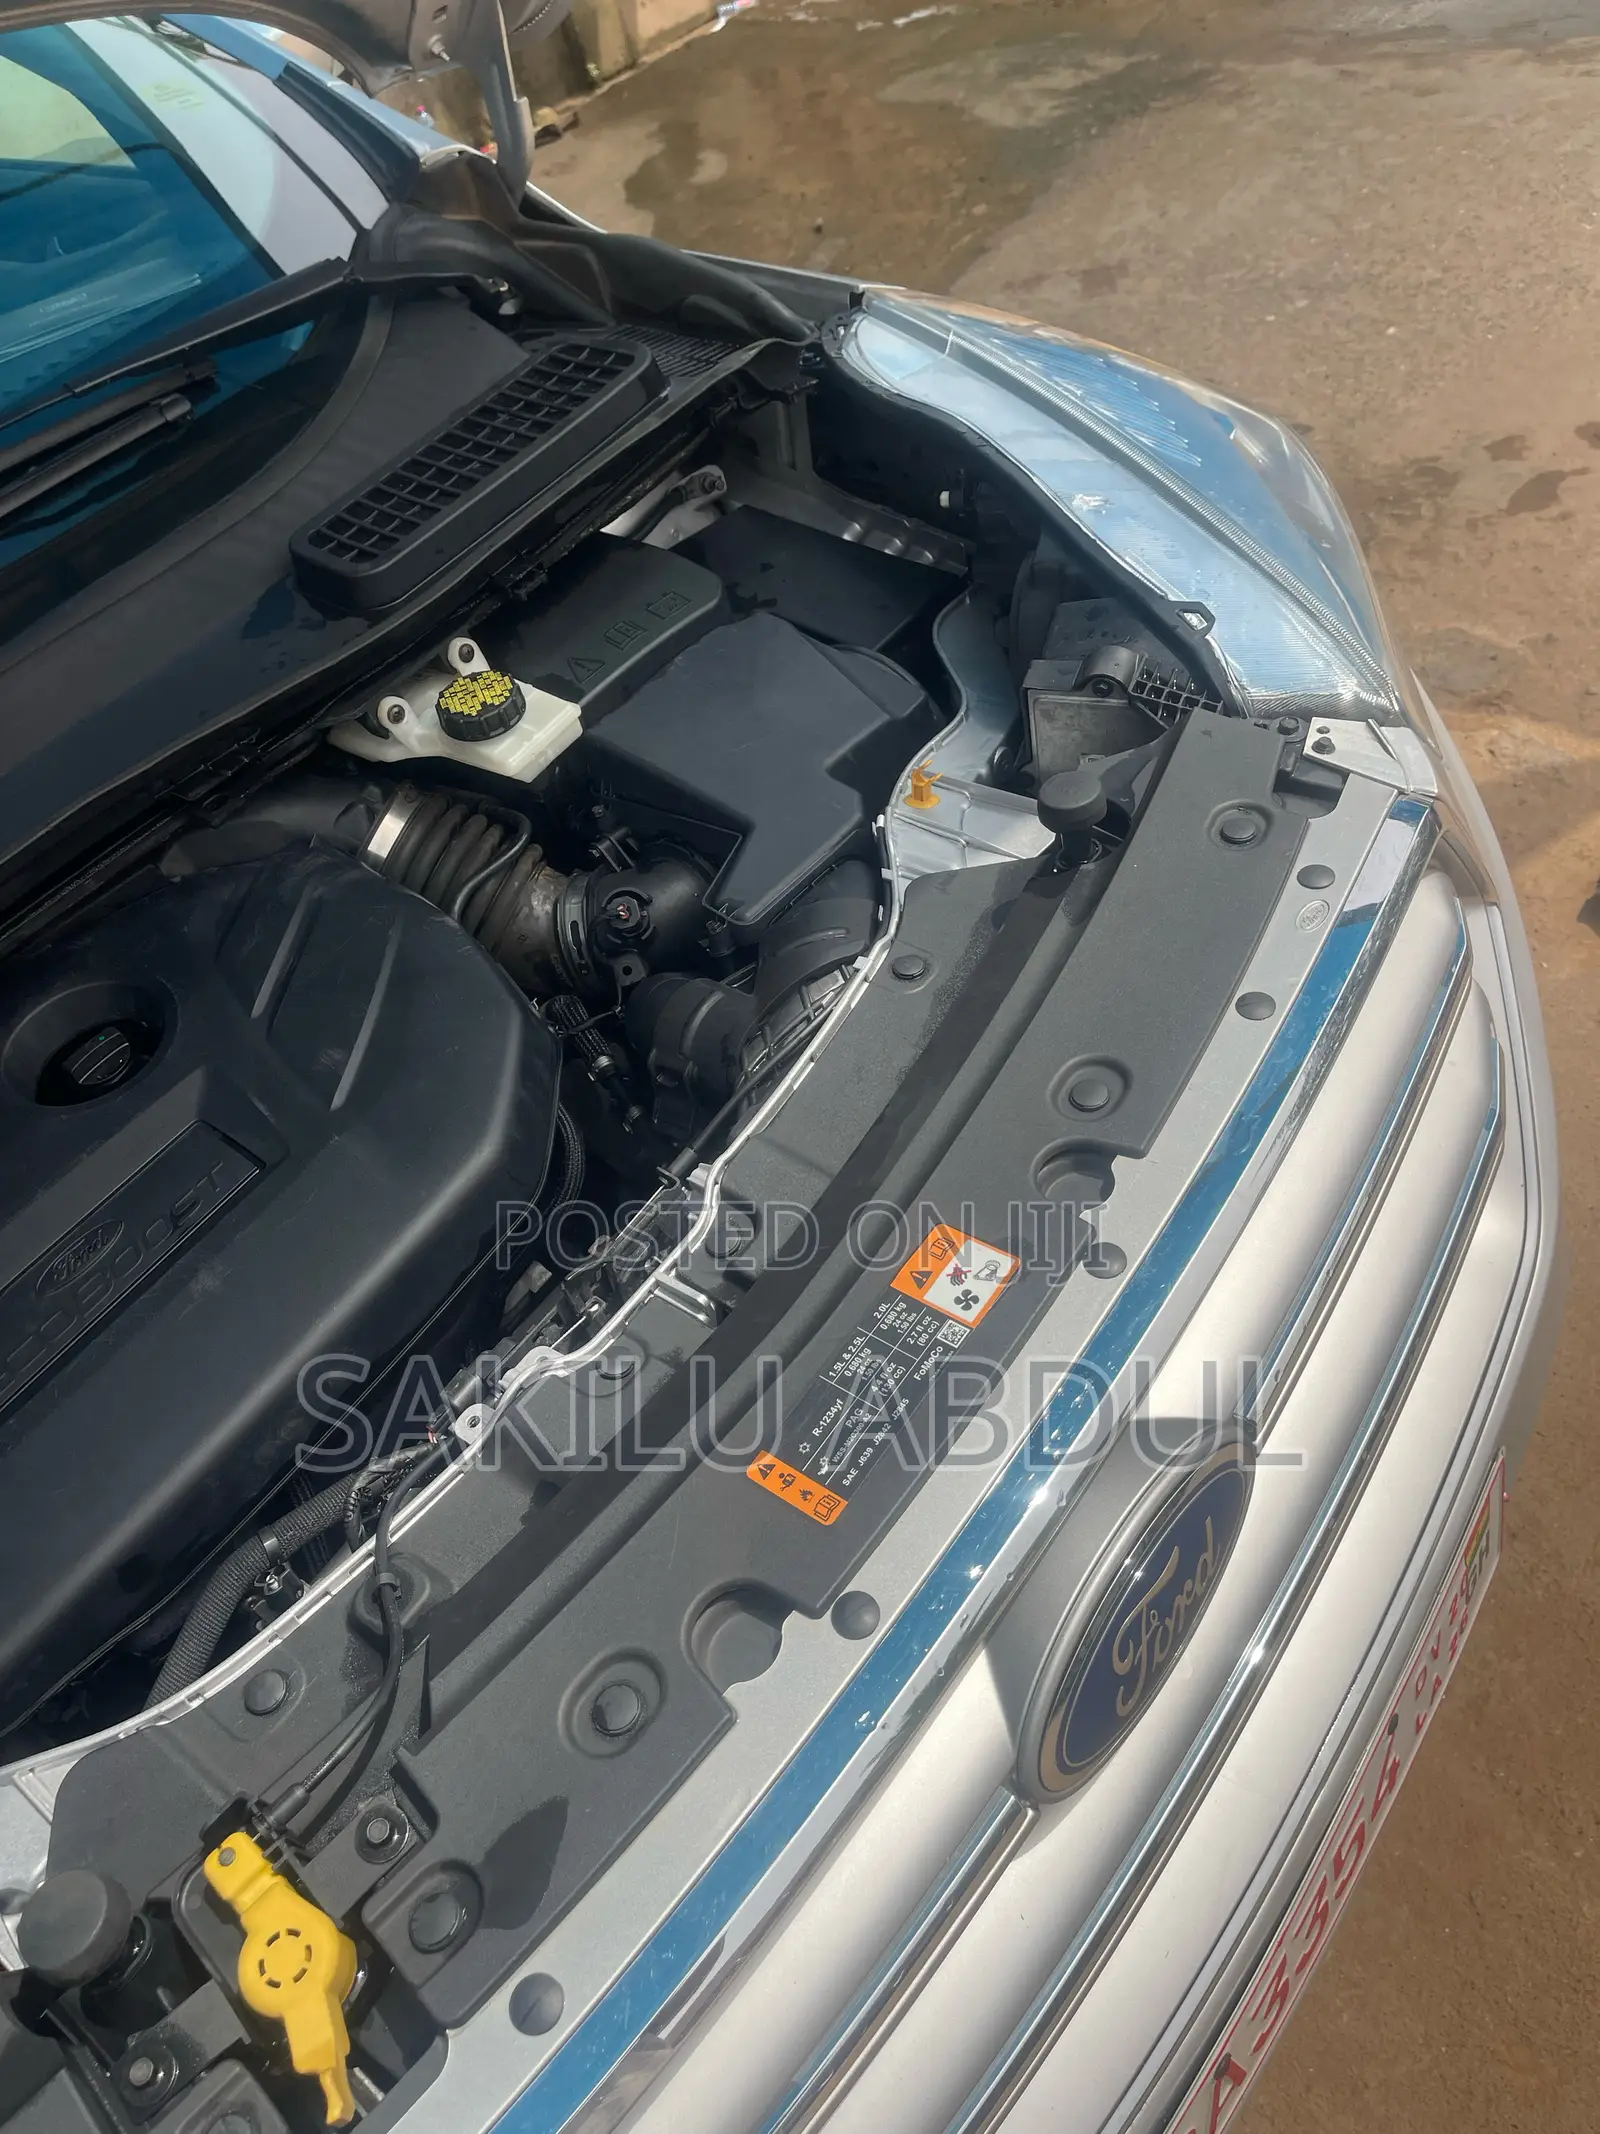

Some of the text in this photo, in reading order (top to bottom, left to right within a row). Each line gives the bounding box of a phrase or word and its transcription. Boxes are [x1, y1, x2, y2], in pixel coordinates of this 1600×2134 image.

[53, 1229, 109, 1281] Ford
[873, 1302, 891, 1319] 2.0L
[879, 1301, 907, 1330] 0.680 kg
[828, 1336, 866, 1379] 1.5L & 2.5L
[843, 1347, 872, 1376] 0.680 kg
[913, 1345, 943, 1380] FoMoCo
[811, 1397, 843, 1436] R-1234yf
[844, 1407, 864, 1428] PAG
[841, 1467, 859, 1486] SAE
[857, 1446, 873, 1466] J639
[891, 1397, 909, 1420] J2845
[1112, 1515, 1216, 1718] Ford
[1187, 1728, 1400, 2134] A3354
